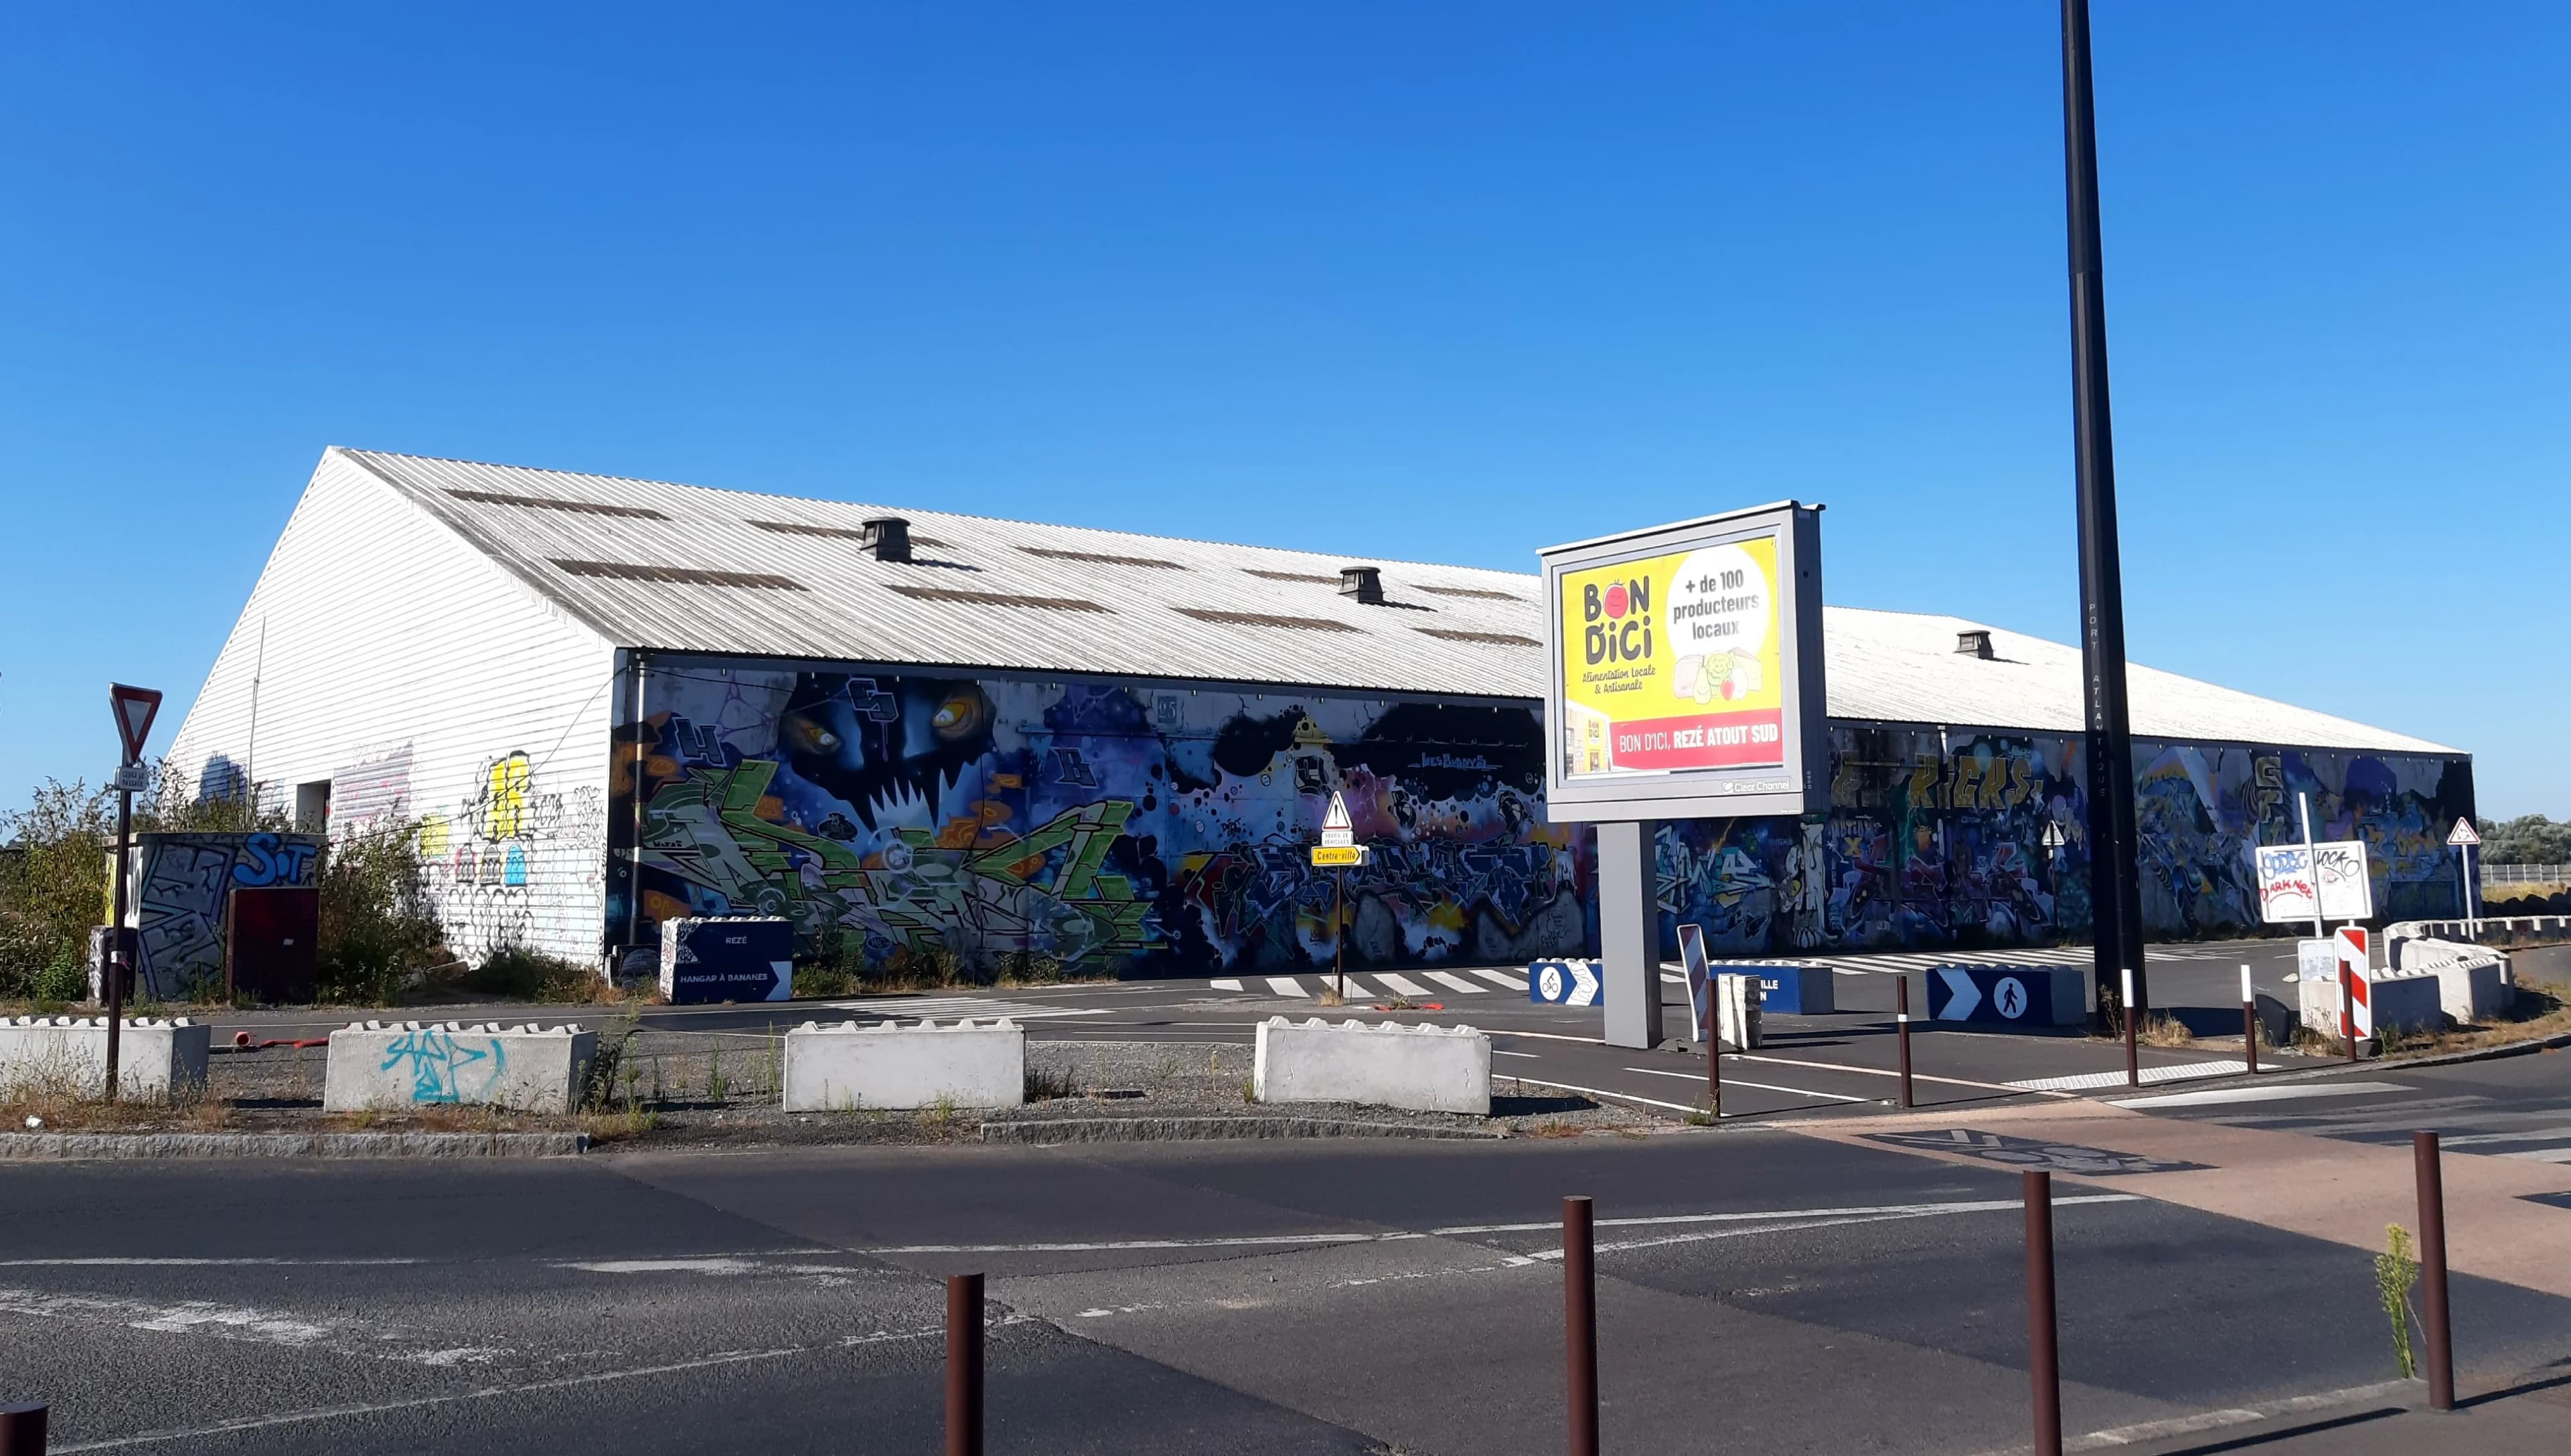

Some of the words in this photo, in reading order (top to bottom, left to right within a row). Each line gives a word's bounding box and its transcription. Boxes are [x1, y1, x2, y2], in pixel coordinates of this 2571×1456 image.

[1699, 574, 1717, 594] de
[1719, 568, 1745, 591] 100
[1584, 575, 1650, 622] BON
[1673, 594, 1760, 625] producteurs
[1692, 620, 1740, 641] locaux
[1582, 667, 1629, 683] Alimentation
[1631, 664, 1656, 677] Locale
[1594, 684, 1602, 694] &
[1603, 679, 1643, 694] Artisanale
[1620, 734, 1642, 753] BON
[1644, 732, 1671, 752] D'ICI,
[1673, 725, 1705, 749] REZÉ
[1707, 725, 1749, 747] ATOUT
[1751, 723, 1779, 743] SUD
[1734, 782, 1756, 793] Clear
[1756, 778, 1790, 791] Channel
[725, 935, 748, 945] REZÉ
[728, 973, 769, 982] BANANES
